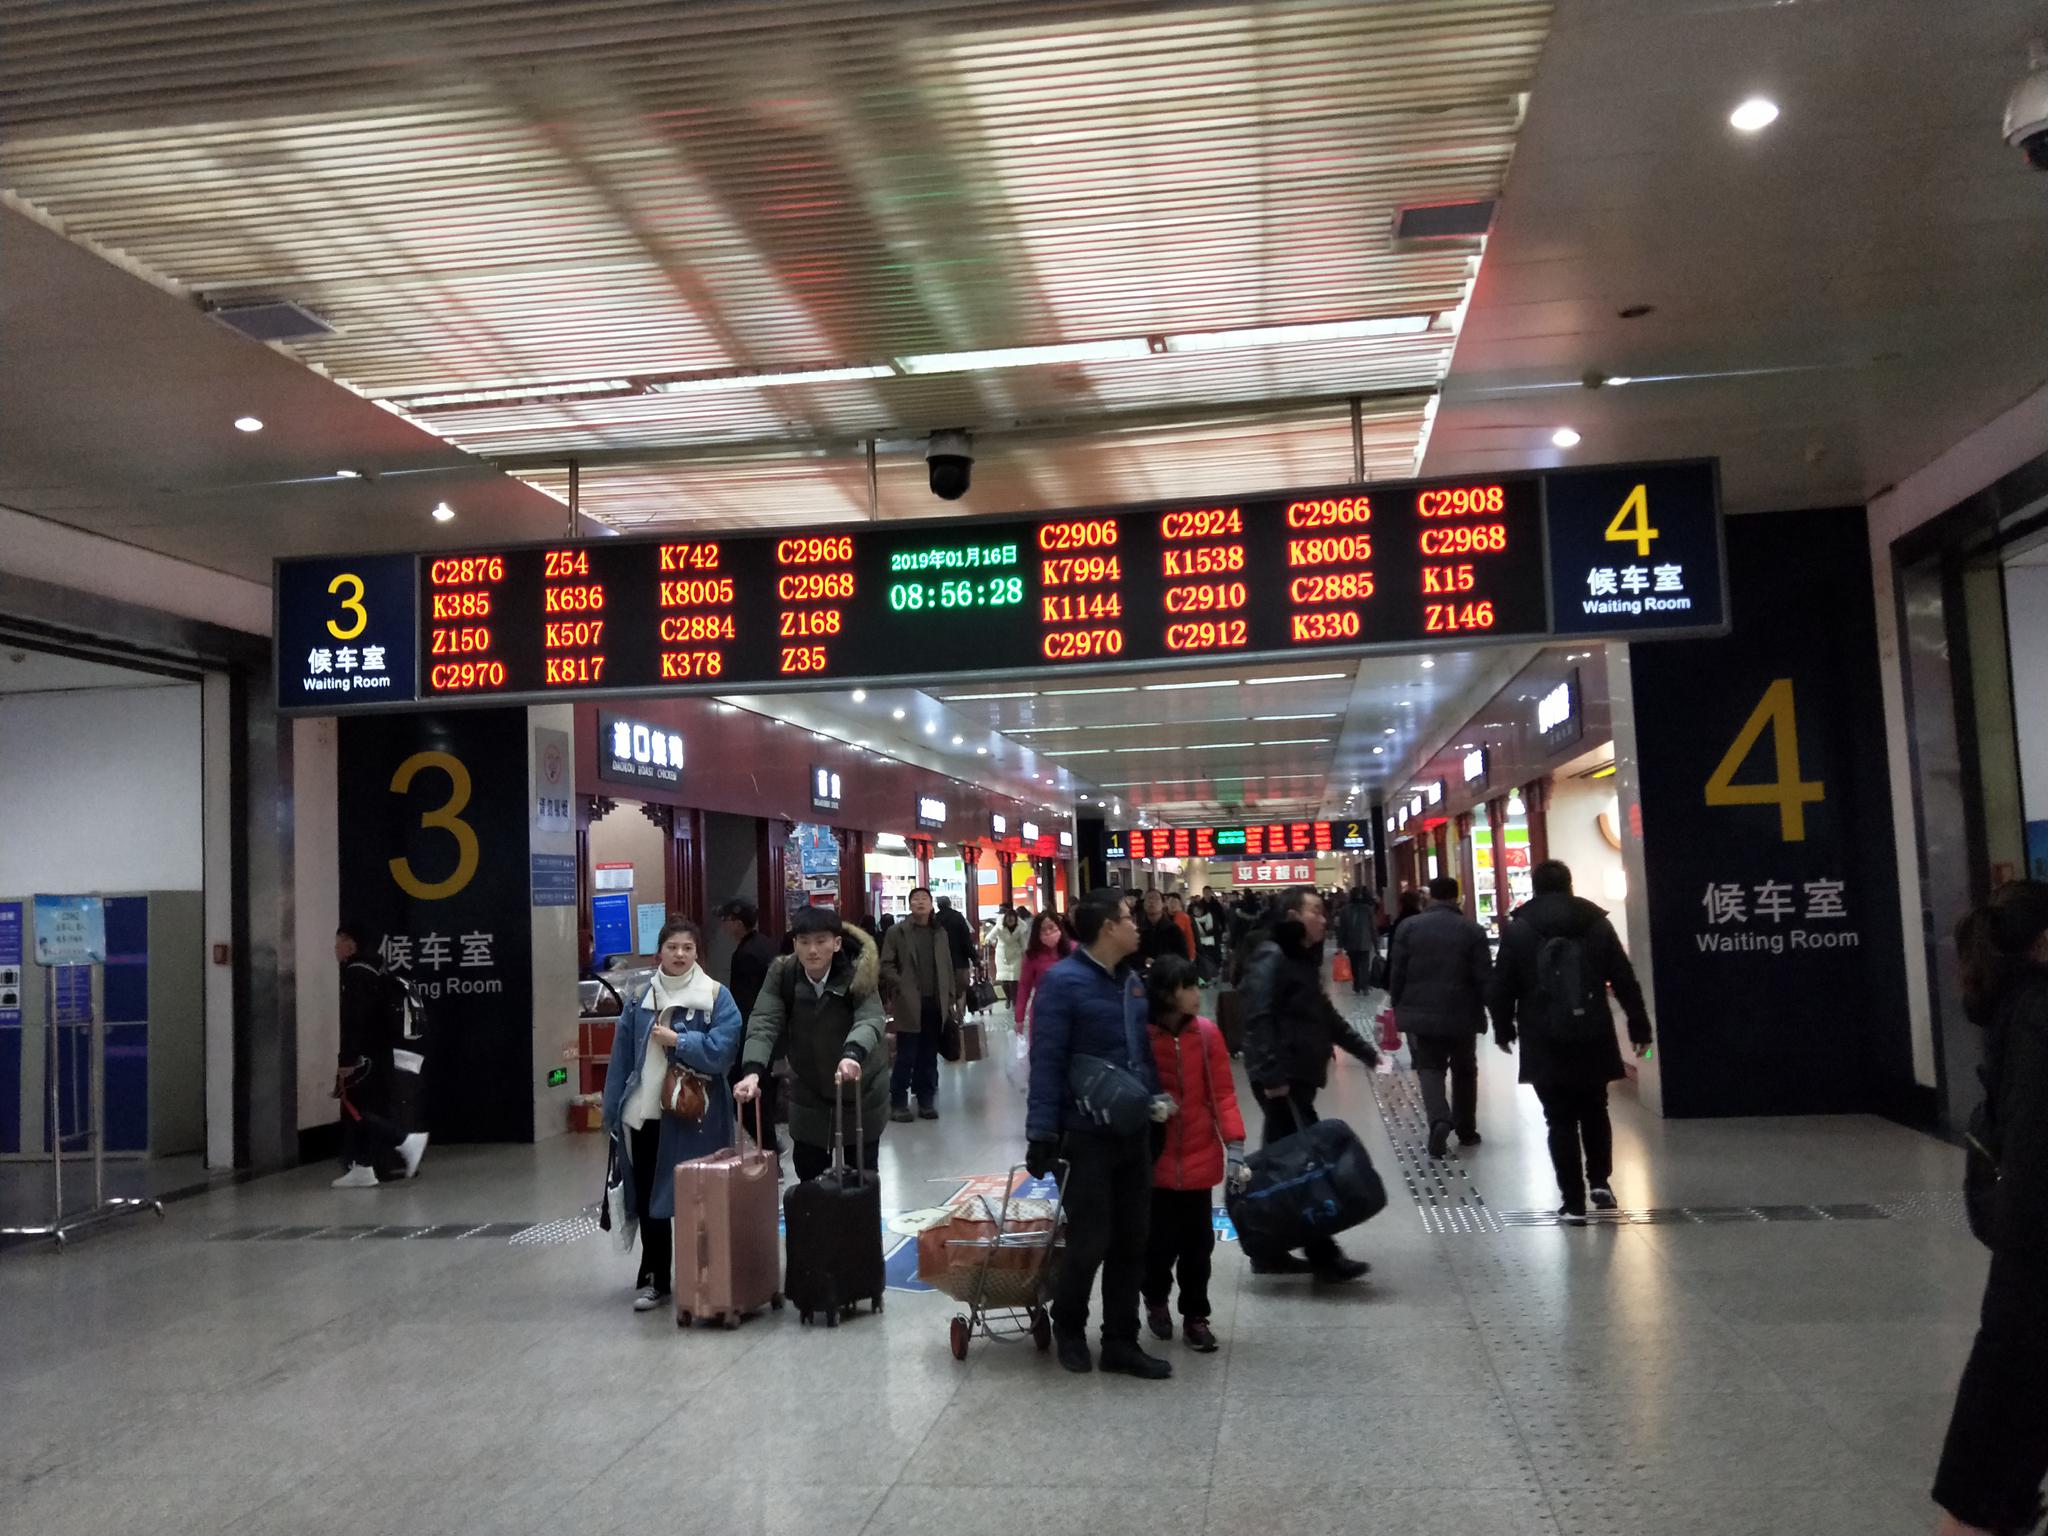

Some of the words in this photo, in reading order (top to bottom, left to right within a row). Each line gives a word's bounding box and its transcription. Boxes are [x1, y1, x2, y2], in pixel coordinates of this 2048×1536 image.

[1287, 496, 1371, 528] C2966
[1418, 486, 1504, 518] C2908
[1039, 519, 1118, 550] C2906
[1161, 508, 1243, 539] C2924
[1605, 484, 1659, 556] 4
[777, 536, 853, 564] C2966
[1288, 534, 1372, 567] K8005
[1420, 525, 1506, 555] C2968
[431, 557, 503, 585] C2876
[544, 551, 589, 577] Z54
[659, 543, 719, 570] K742
[891, 545, 1017, 571] 2019年01月16日
[1042, 555, 1121, 585] K7994
[1163, 545, 1245, 576] K1538
[660, 578, 734, 607] K8005
[778, 572, 855, 600] C2968
[1290, 571, 1374, 604] C2885
[1422, 564, 1475, 593] K15
[1586, 562, 1684, 597] 候车室
[326, 573, 368, 640] 3
[432, 592, 490, 619] K385
[545, 585, 603, 612] K636
[889, 577, 1023, 610] 08:56:28
[1042, 592, 1122, 622] K1144
[1165, 582, 1247, 613] C2910
[1582, 598, 1642, 615] Waiting
[1644, 595, 1691, 611] Room
[660, 615, 736, 641] C2884
[780, 609, 841, 637] Z168
[1292, 611, 1360, 641] K330
[1425, 601, 1494, 631] Z146
[431, 627, 489, 654] Z150
[545, 620, 604, 648] K507
[1043, 629, 1123, 658] C2970
[1166, 619, 1248, 650] C2912
[307, 645, 386, 674] 候车室
[546, 656, 605, 683] K817
[661, 651, 722, 678] K378
[781, 646, 826, 672] Z35
[303, 676, 351, 692] Waiting
[353, 674, 391, 689] Room
[431, 661, 504, 689] C2970
[1705, 679, 1824, 841] 4
[390, 751, 479, 900] 3
[1347, 823, 1359, 838] 2
[1110, 833, 1119, 848] 1
[1702, 877, 1847, 924] 候车室
[377, 930, 494, 971] 候车室
[1696, 931, 1784, 954] Waiting
[1790, 930, 1858, 949] Room
[446, 977, 502, 994] Room
